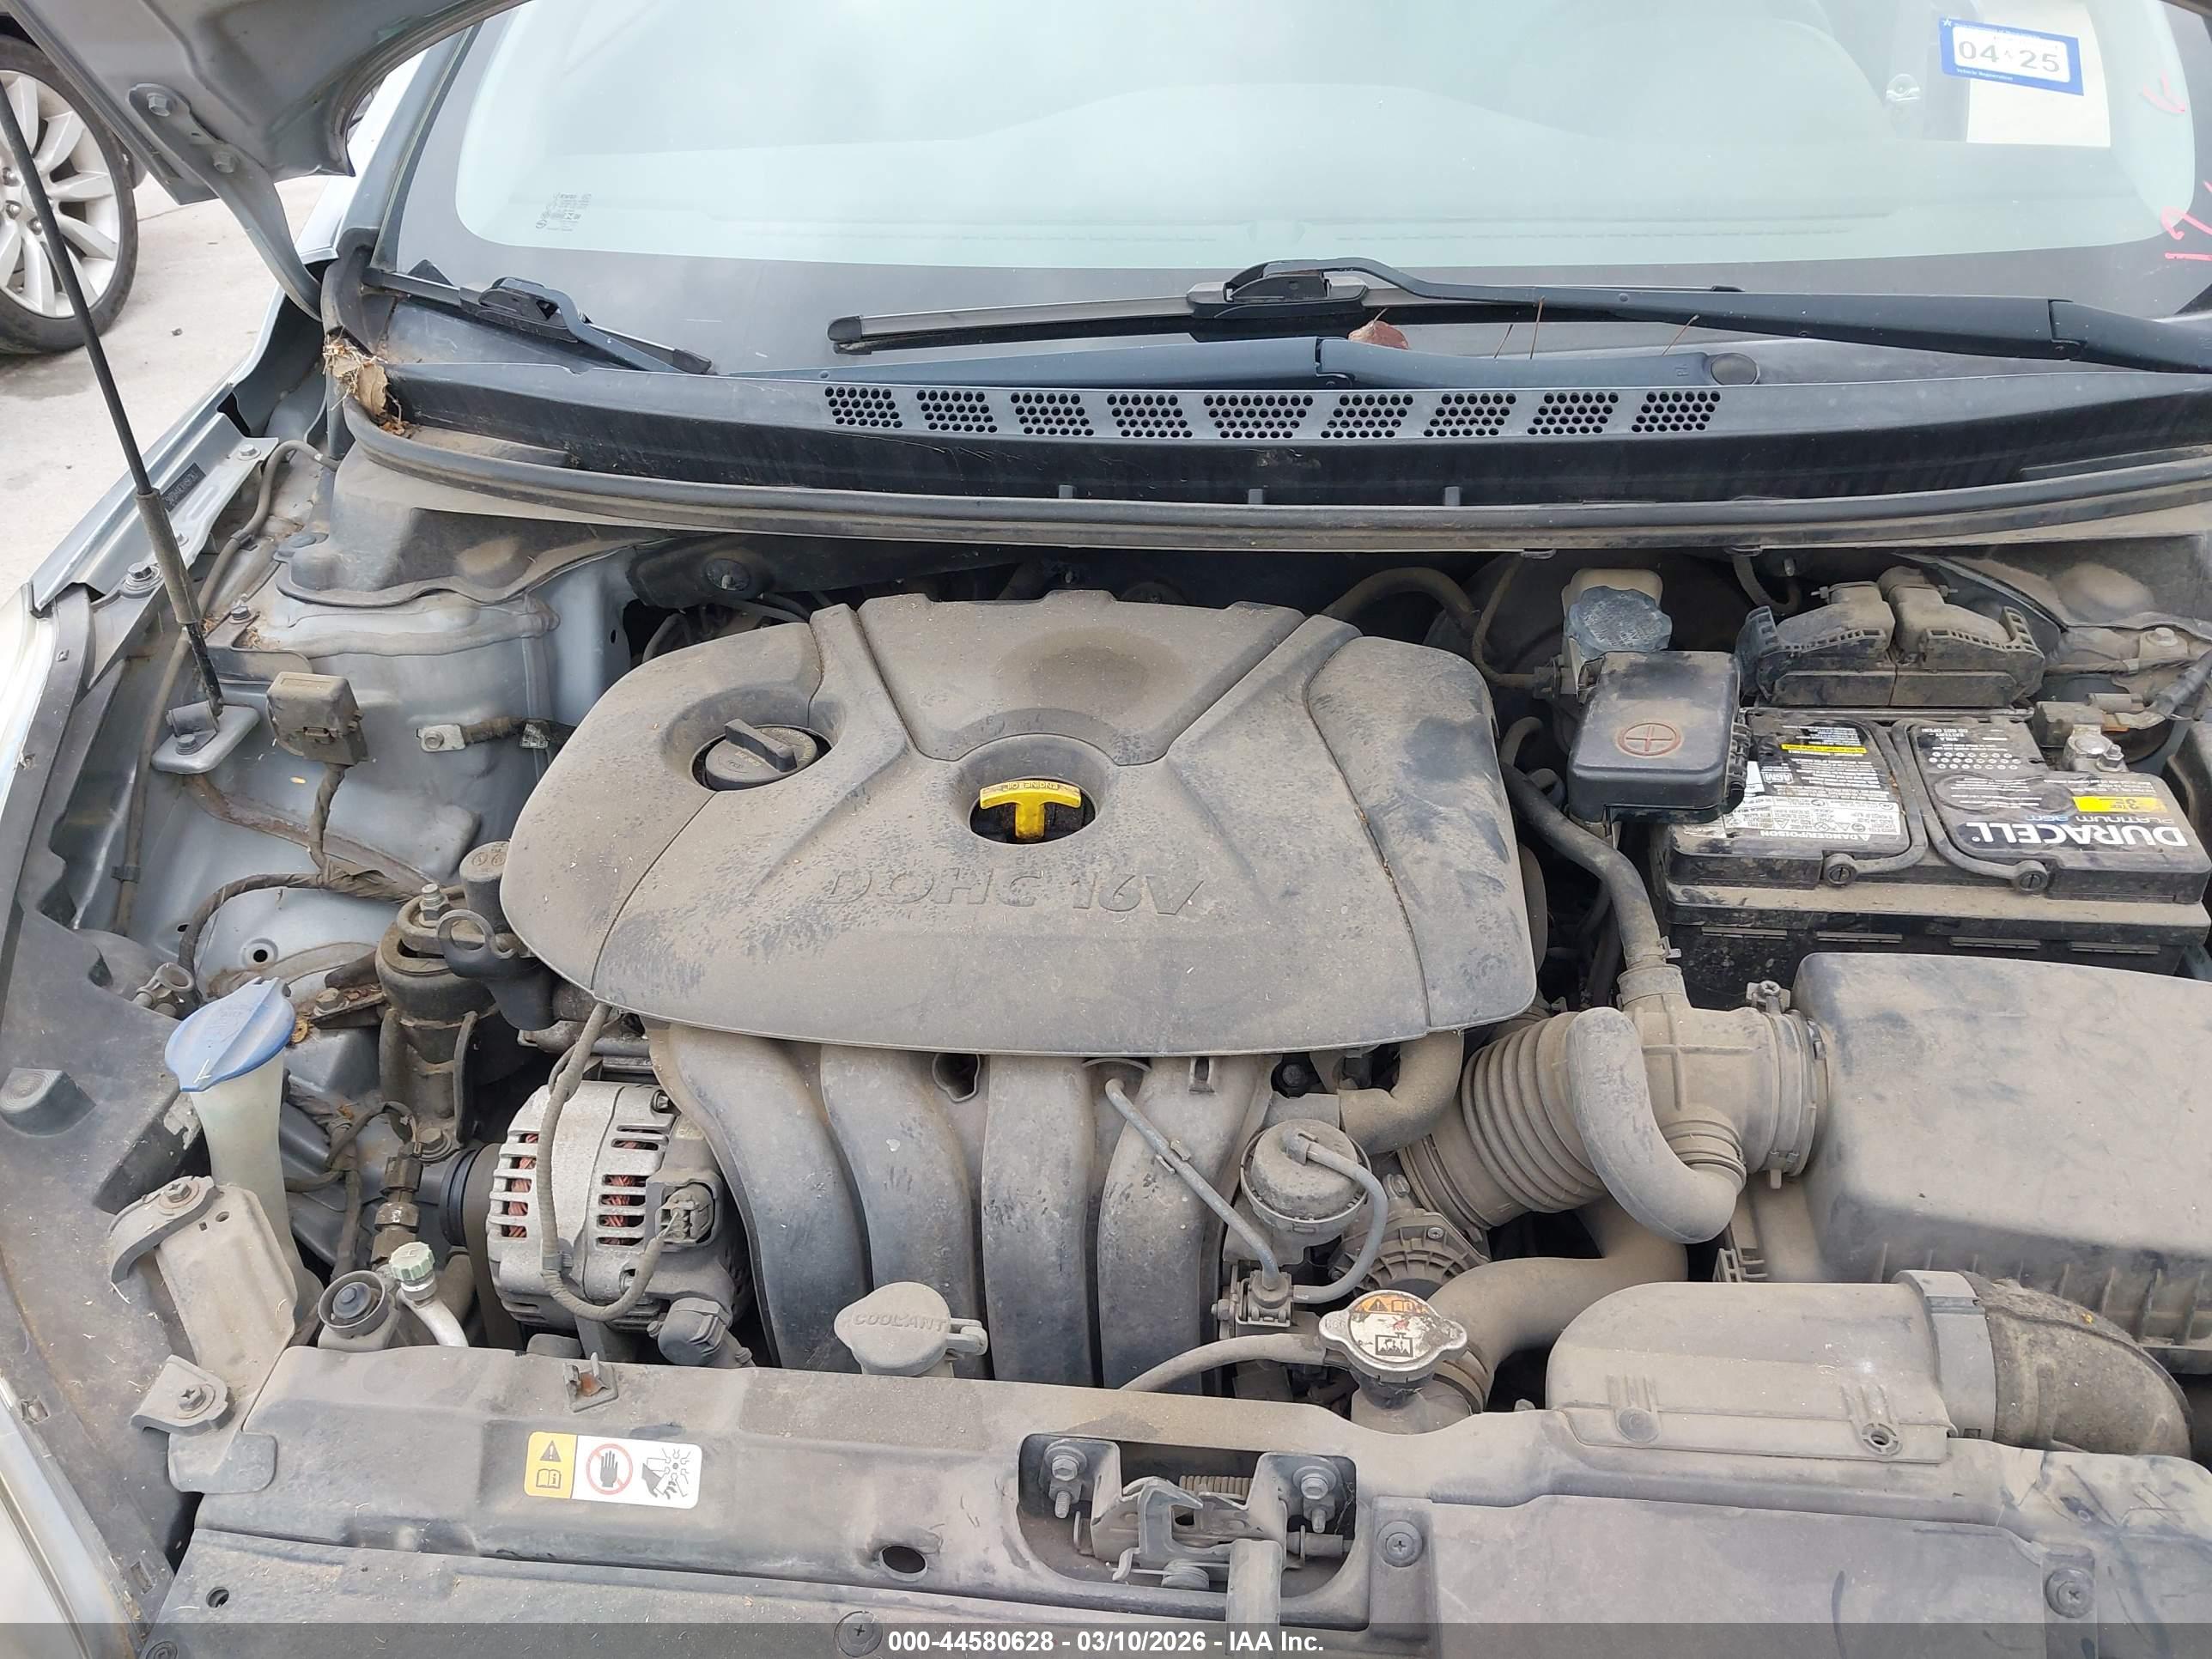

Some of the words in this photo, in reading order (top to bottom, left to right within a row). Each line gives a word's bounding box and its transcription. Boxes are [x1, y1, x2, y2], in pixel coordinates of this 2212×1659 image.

[1958, 40, 2000, 64] 04
[2020, 49, 2061, 73] 25
[1024, 781, 1059, 790] ENGINE
[1966, 822, 2189, 848] DURACELL
[815, 866, 1044, 907] DOHC
[1070, 872, 1205, 915] 16V
[854, 1312, 948, 1332] COOLANT
